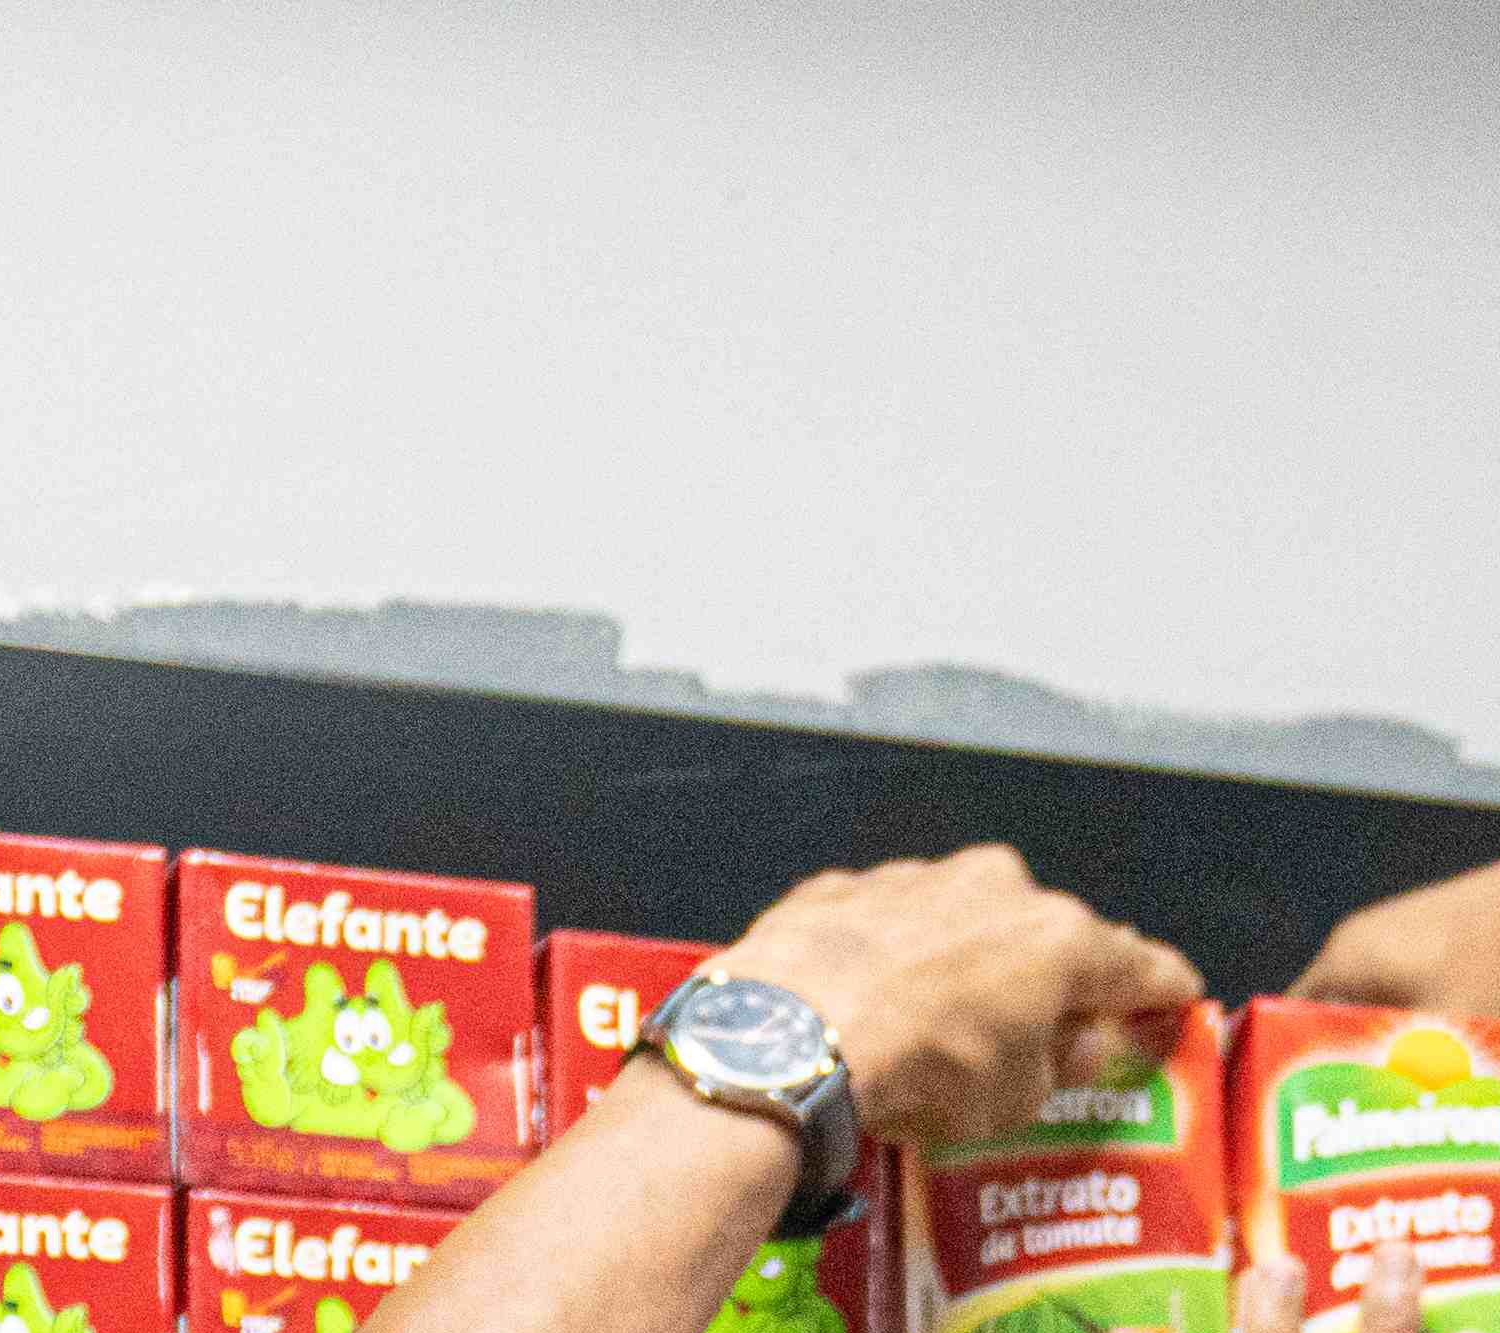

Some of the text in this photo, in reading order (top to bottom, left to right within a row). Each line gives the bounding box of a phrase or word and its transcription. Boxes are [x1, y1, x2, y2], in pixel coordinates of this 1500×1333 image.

[224, 881, 488, 963] Elefante
[980, 1171, 1141, 1225] Extrato
[1329, 1193, 1494, 1251] Extrato
[1022, 1214, 1141, 1256] tomate
